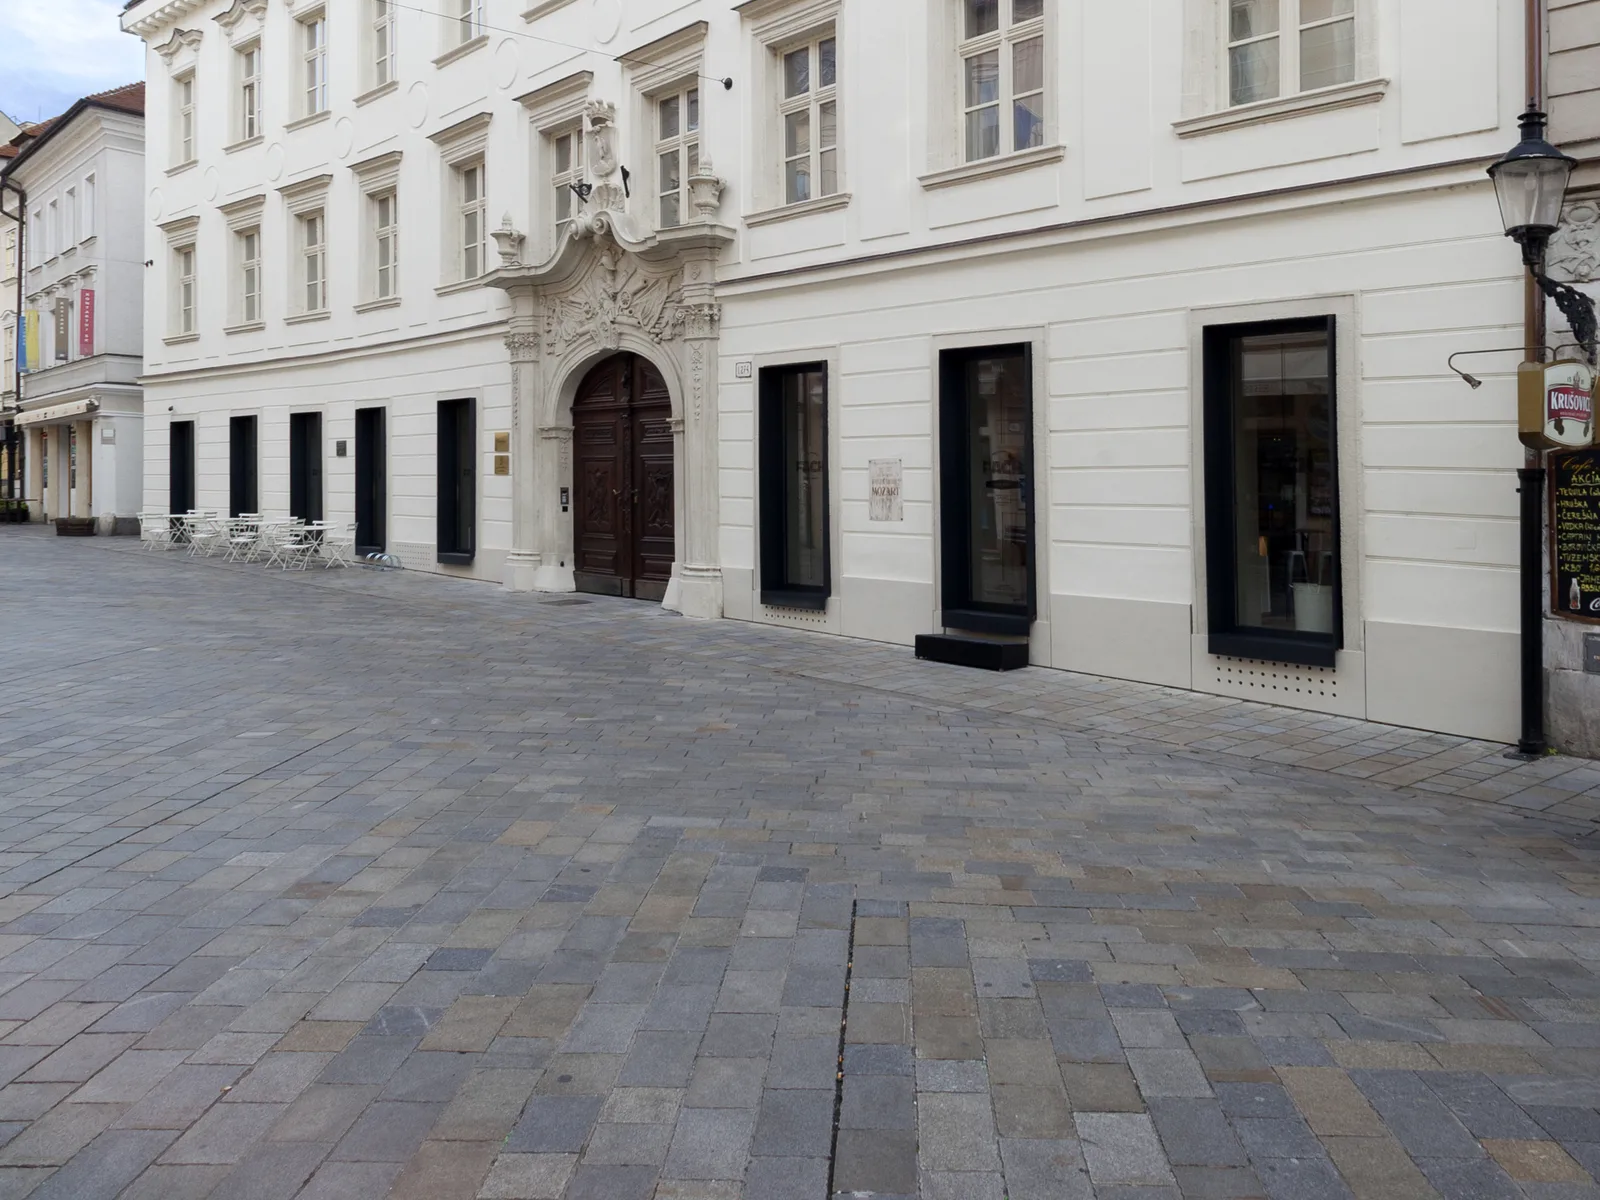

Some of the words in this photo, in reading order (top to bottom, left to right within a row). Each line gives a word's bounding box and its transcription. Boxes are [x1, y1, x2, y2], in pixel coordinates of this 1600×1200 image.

[872, 486, 899, 496] MOZART
[1561, 533, 1591, 541] CAPTAIN
[1561, 553, 1600, 562] TUZEMSK
